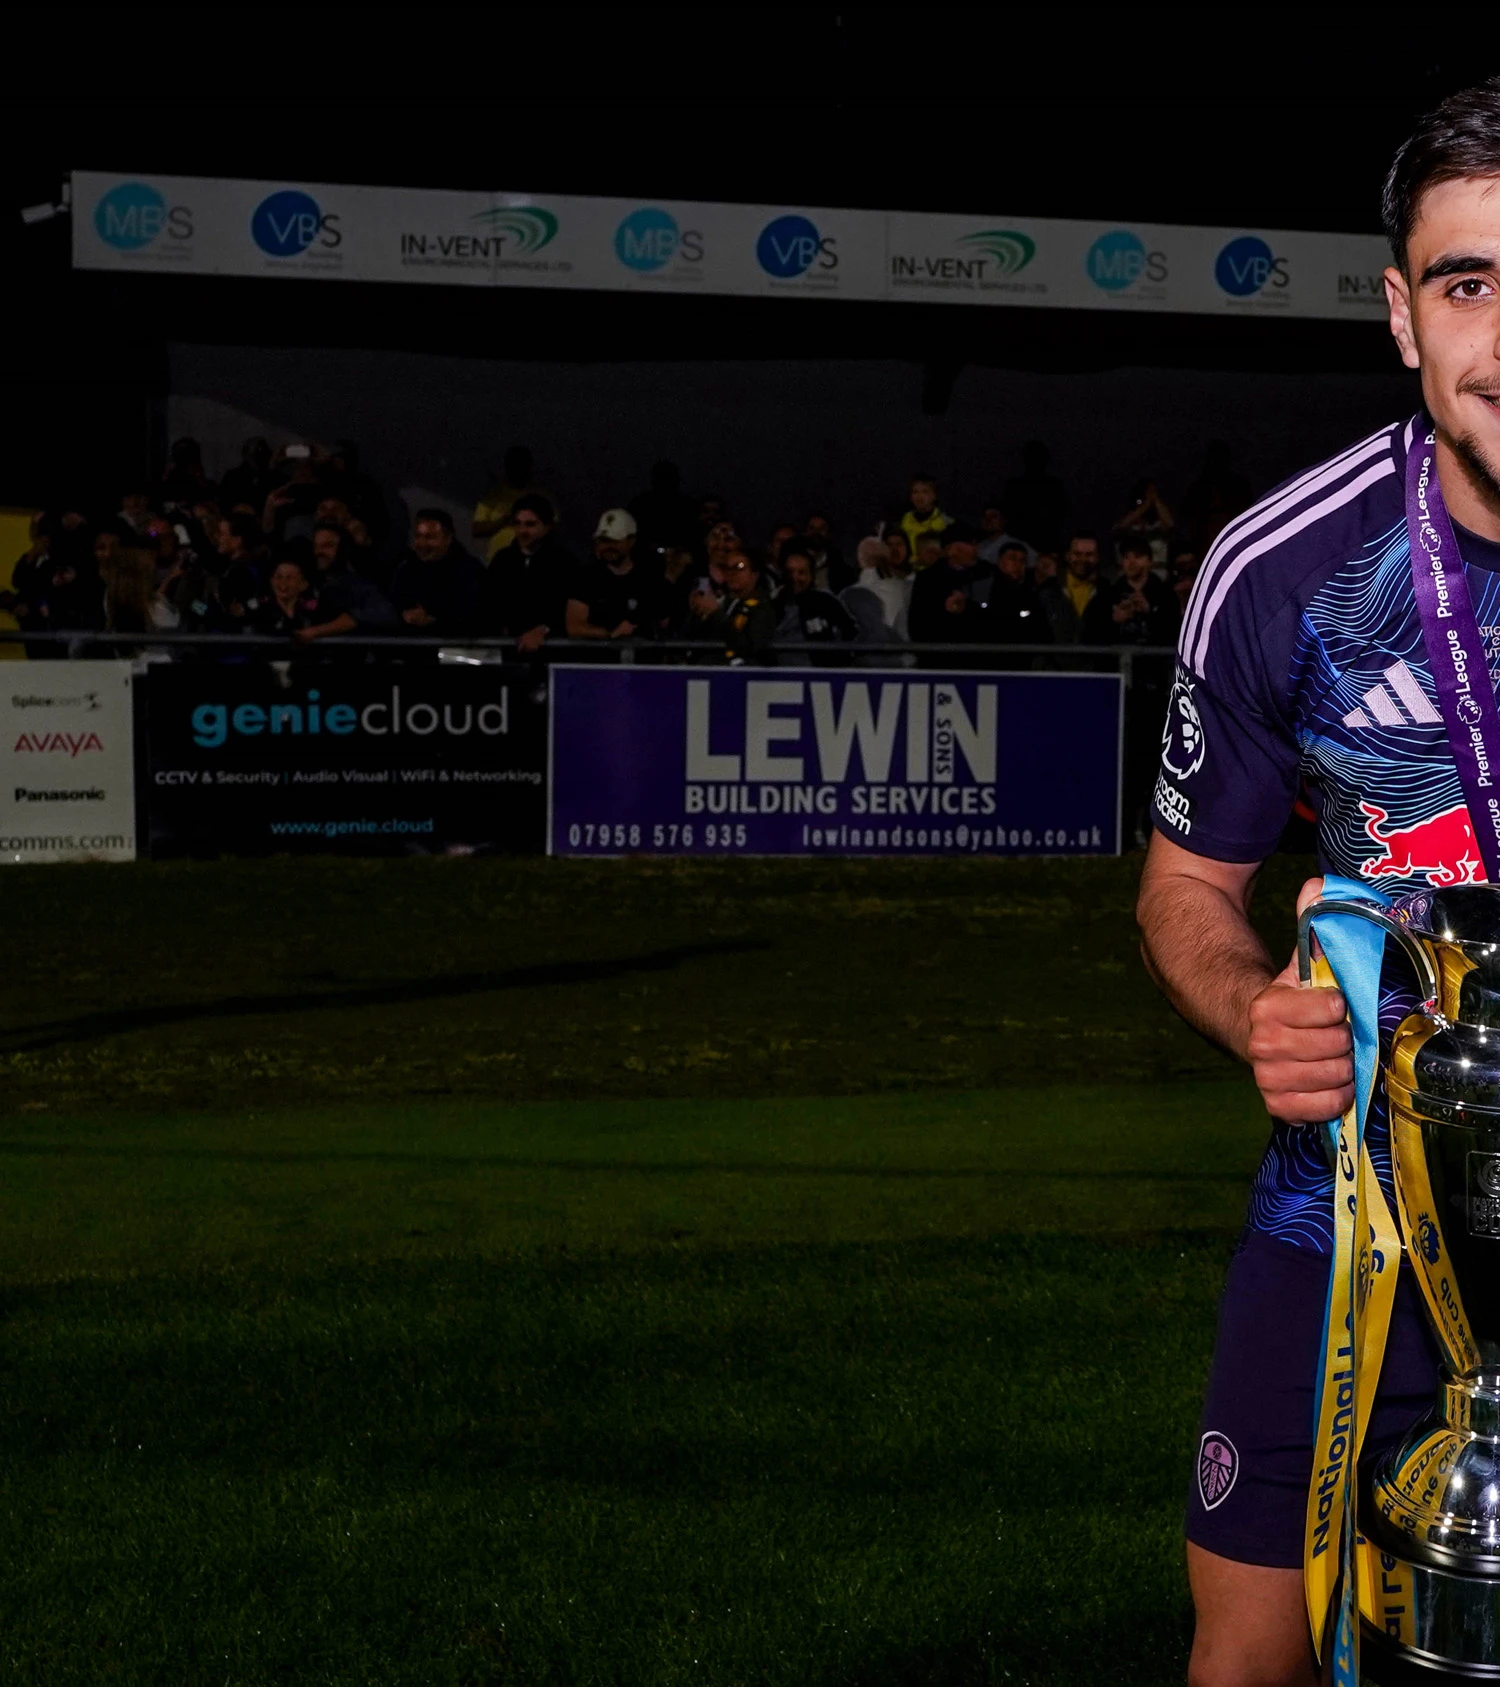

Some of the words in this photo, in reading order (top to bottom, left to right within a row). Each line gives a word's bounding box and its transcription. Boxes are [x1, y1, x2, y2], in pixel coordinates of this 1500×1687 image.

[105, 203, 194, 241] MBS
[266, 211, 343, 249] VBS
[401, 233, 506, 258] IN-VENT
[623, 228, 705, 263] MBS
[769, 236, 840, 270] VBS
[891, 255, 988, 280] IN-VENT
[1093, 249, 1168, 283] MBS
[1225, 255, 1290, 289] VBS
[1337, 274, 1387, 295] IN-V
[1417, 456, 1431, 521] League
[1429, 554, 1453, 619] Premier
[1446, 629, 1471, 694] League
[937, 692, 952, 705] &
[191, 684, 509, 748] geniecloud
[685, 679, 999, 783] LEWIN
[936, 718, 952, 775] SONS
[1469, 726, 1494, 788] Premier
[14, 787, 106, 802] Panasonic
[155, 770, 198, 785] CCTV
[201, 771, 213, 784] &
[216, 770, 281, 787] Security
[292, 769, 339, 784] Audio
[341, 769, 389, 783] Visual
[400, 770, 436, 783] WiFi
[438, 770, 449, 783] &
[453, 768, 543, 786] Networking
[685, 785, 837, 814] BUILDING
[851, 785, 997, 815] SERVICES
[1155, 787, 1193, 836] racism
[0, 834, 125, 851] comms.com
[269, 817, 434, 838] www.genie.cloud
[568, 823, 642, 848] 07958
[653, 823, 694, 848] 576
[705, 823, 748, 848] 935
[803, 823, 1102, 851] lewinandsons@yahoo.co.uk
[1311, 1370, 1355, 1560] National
